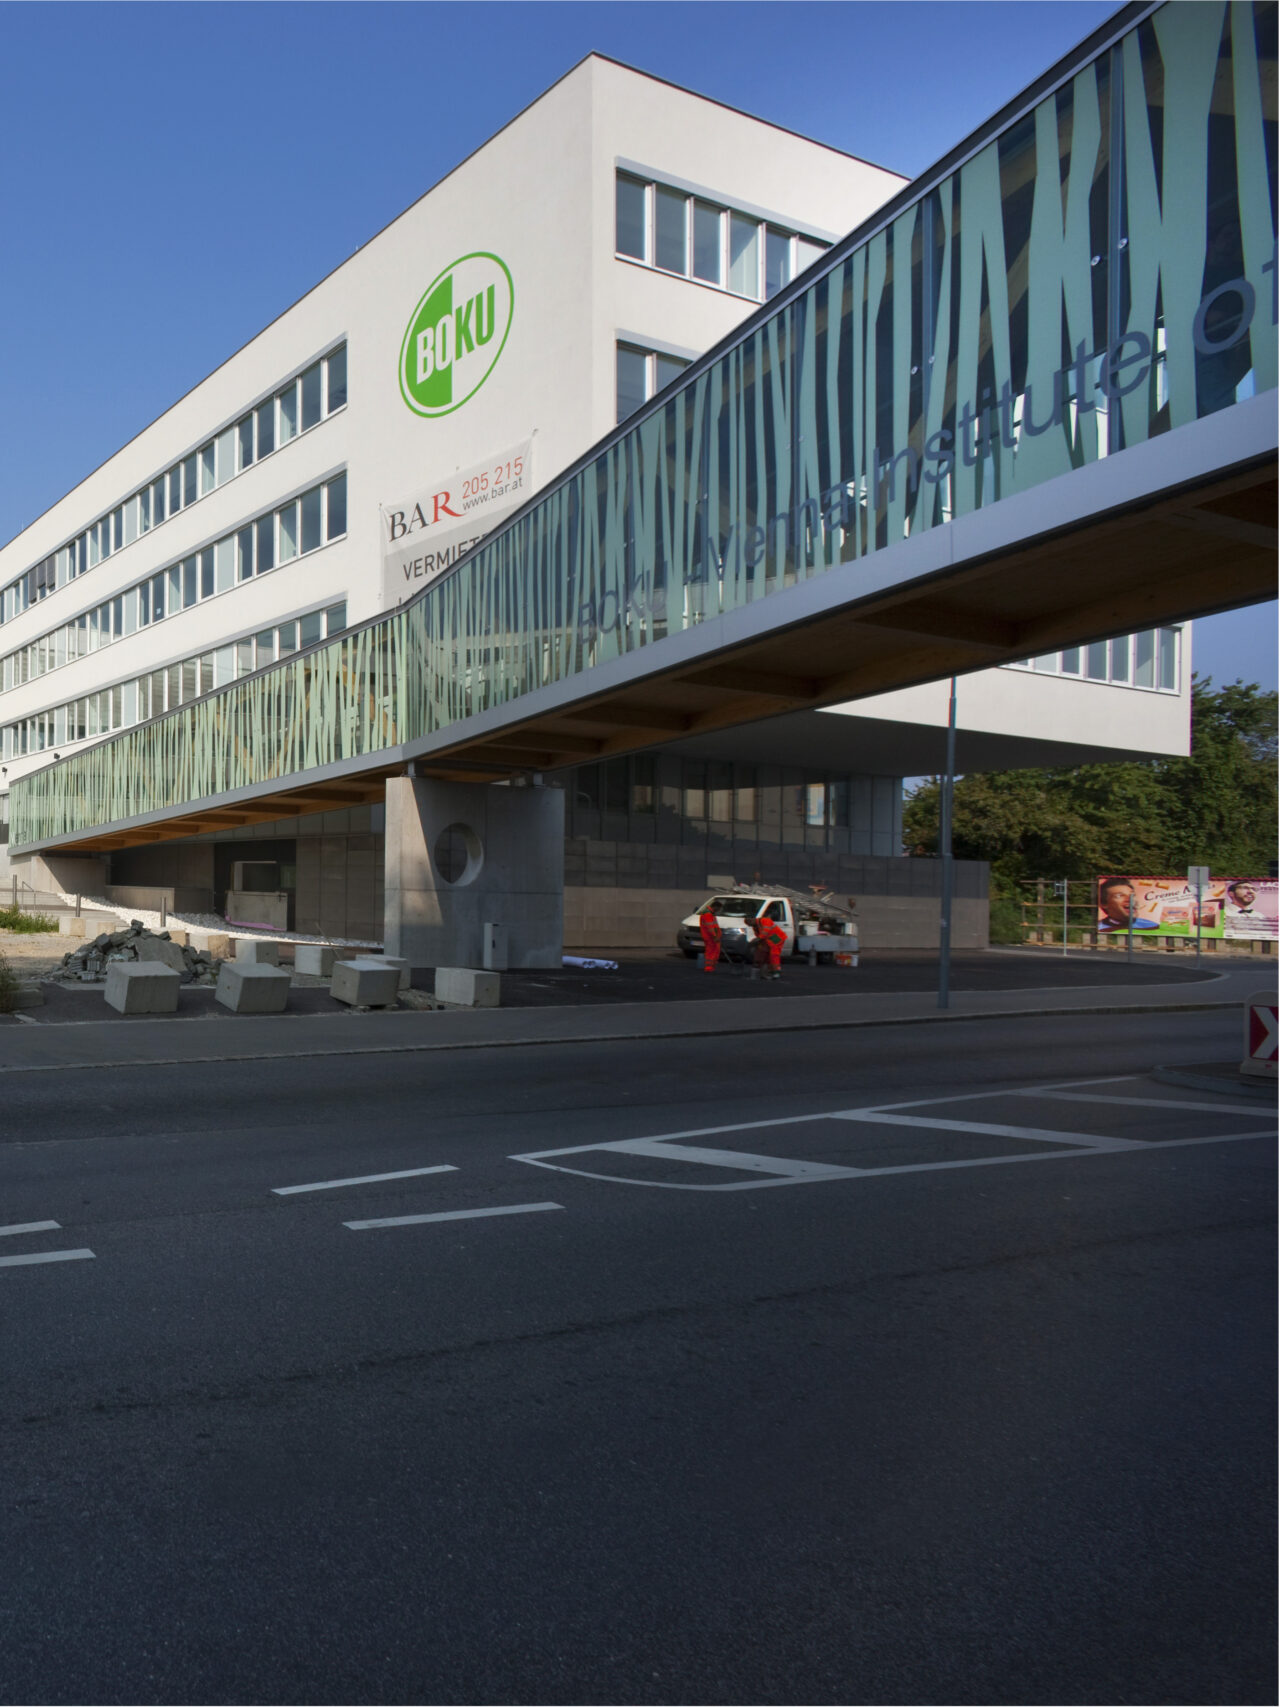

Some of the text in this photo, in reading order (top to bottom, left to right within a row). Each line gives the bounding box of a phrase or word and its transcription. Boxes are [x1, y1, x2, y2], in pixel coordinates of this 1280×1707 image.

[416, 283, 495, 385] BOKU
[462, 456, 524, 499] 205 215
[462, 477, 524, 511] www.bar.at
[579, 560, 669, 644] BOKU
[707, 481, 849, 580] Vienna
[872, 330, 1152, 511] Institute
[388, 490, 467, 543] BAR
[402, 532, 490, 582] VERMIE
[1144, 890, 1180, 901] Creme
